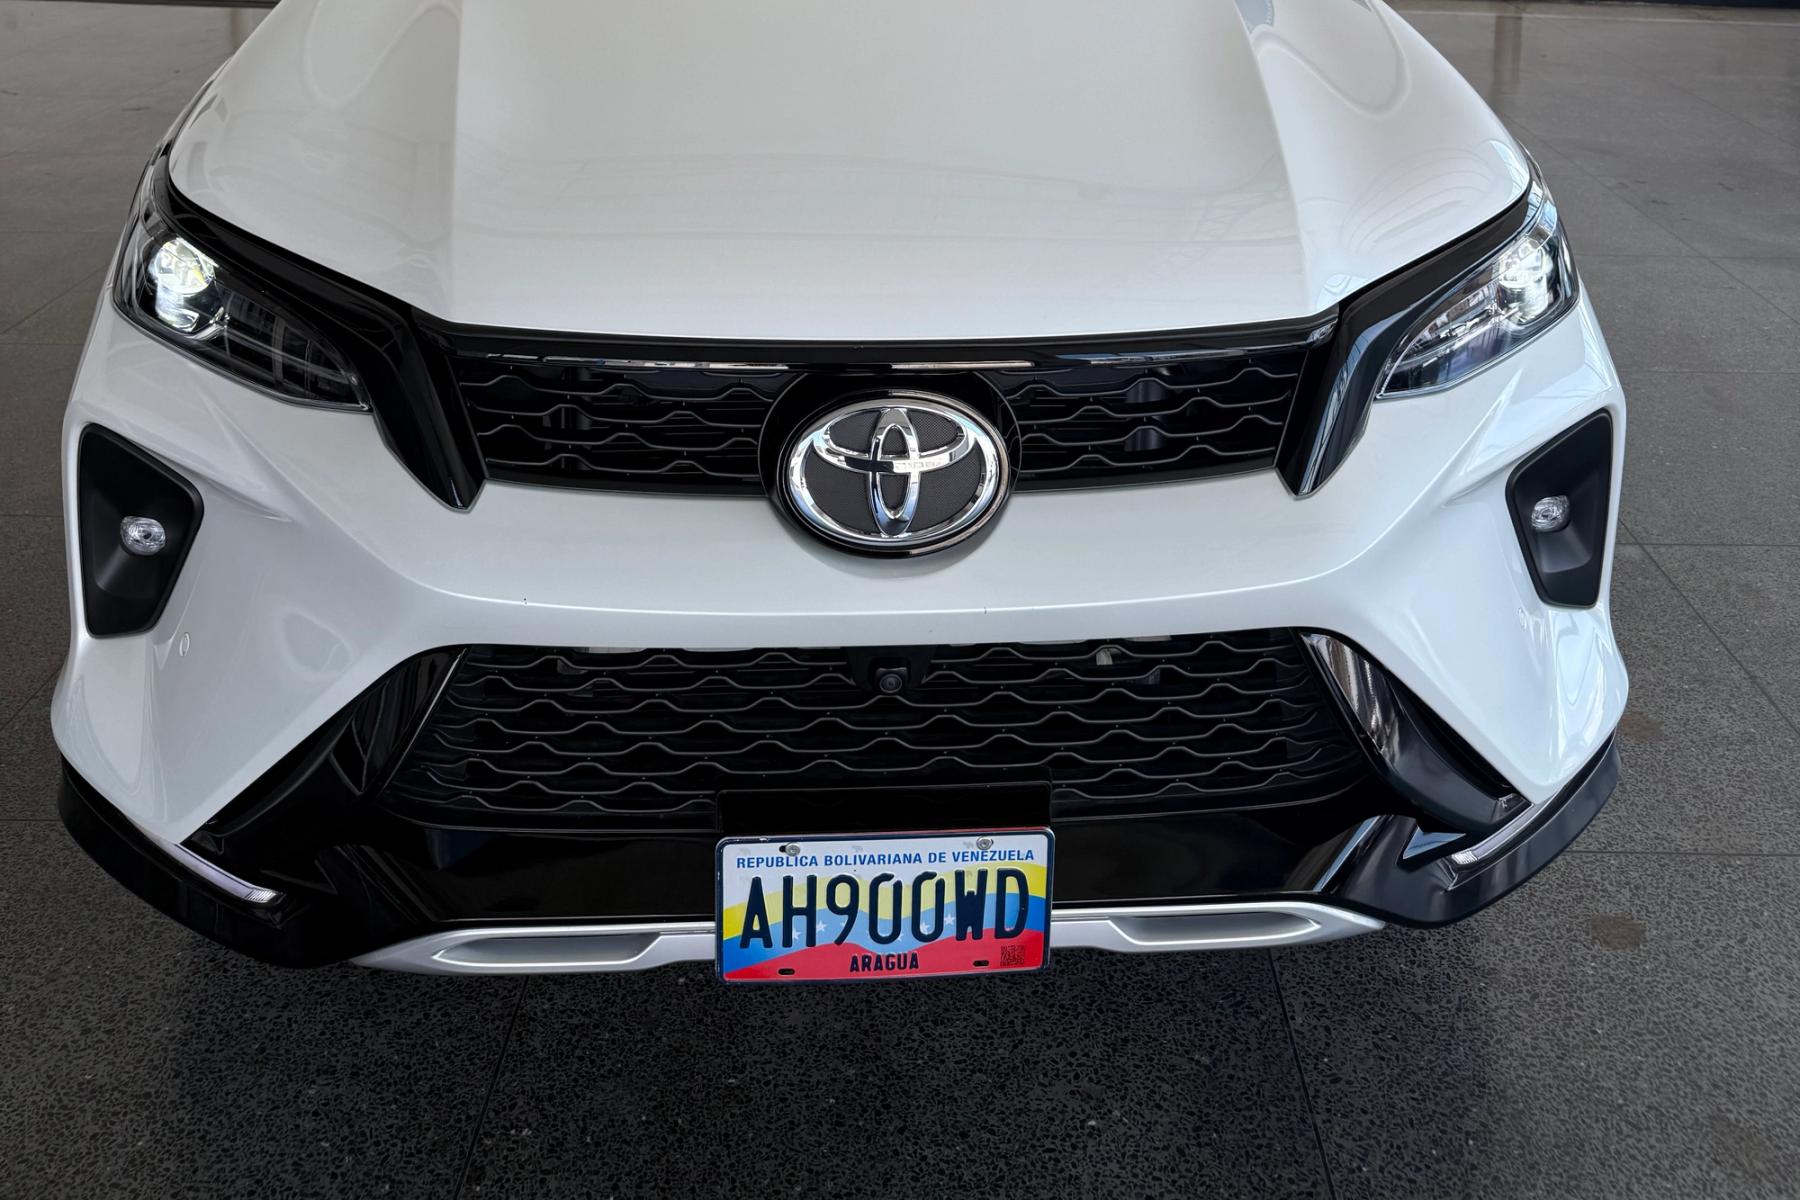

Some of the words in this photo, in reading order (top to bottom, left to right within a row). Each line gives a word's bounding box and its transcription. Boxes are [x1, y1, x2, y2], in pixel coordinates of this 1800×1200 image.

[736, 855, 819, 869] REPUBLICA
[824, 853, 923, 867] BOLIVARIANA
[928, 851, 947, 864] DE
[951, 849, 1035, 863] VENEZUELA
[739, 868, 1030, 949] AH900WD
[849, 952, 919, 973] ARAGUA
